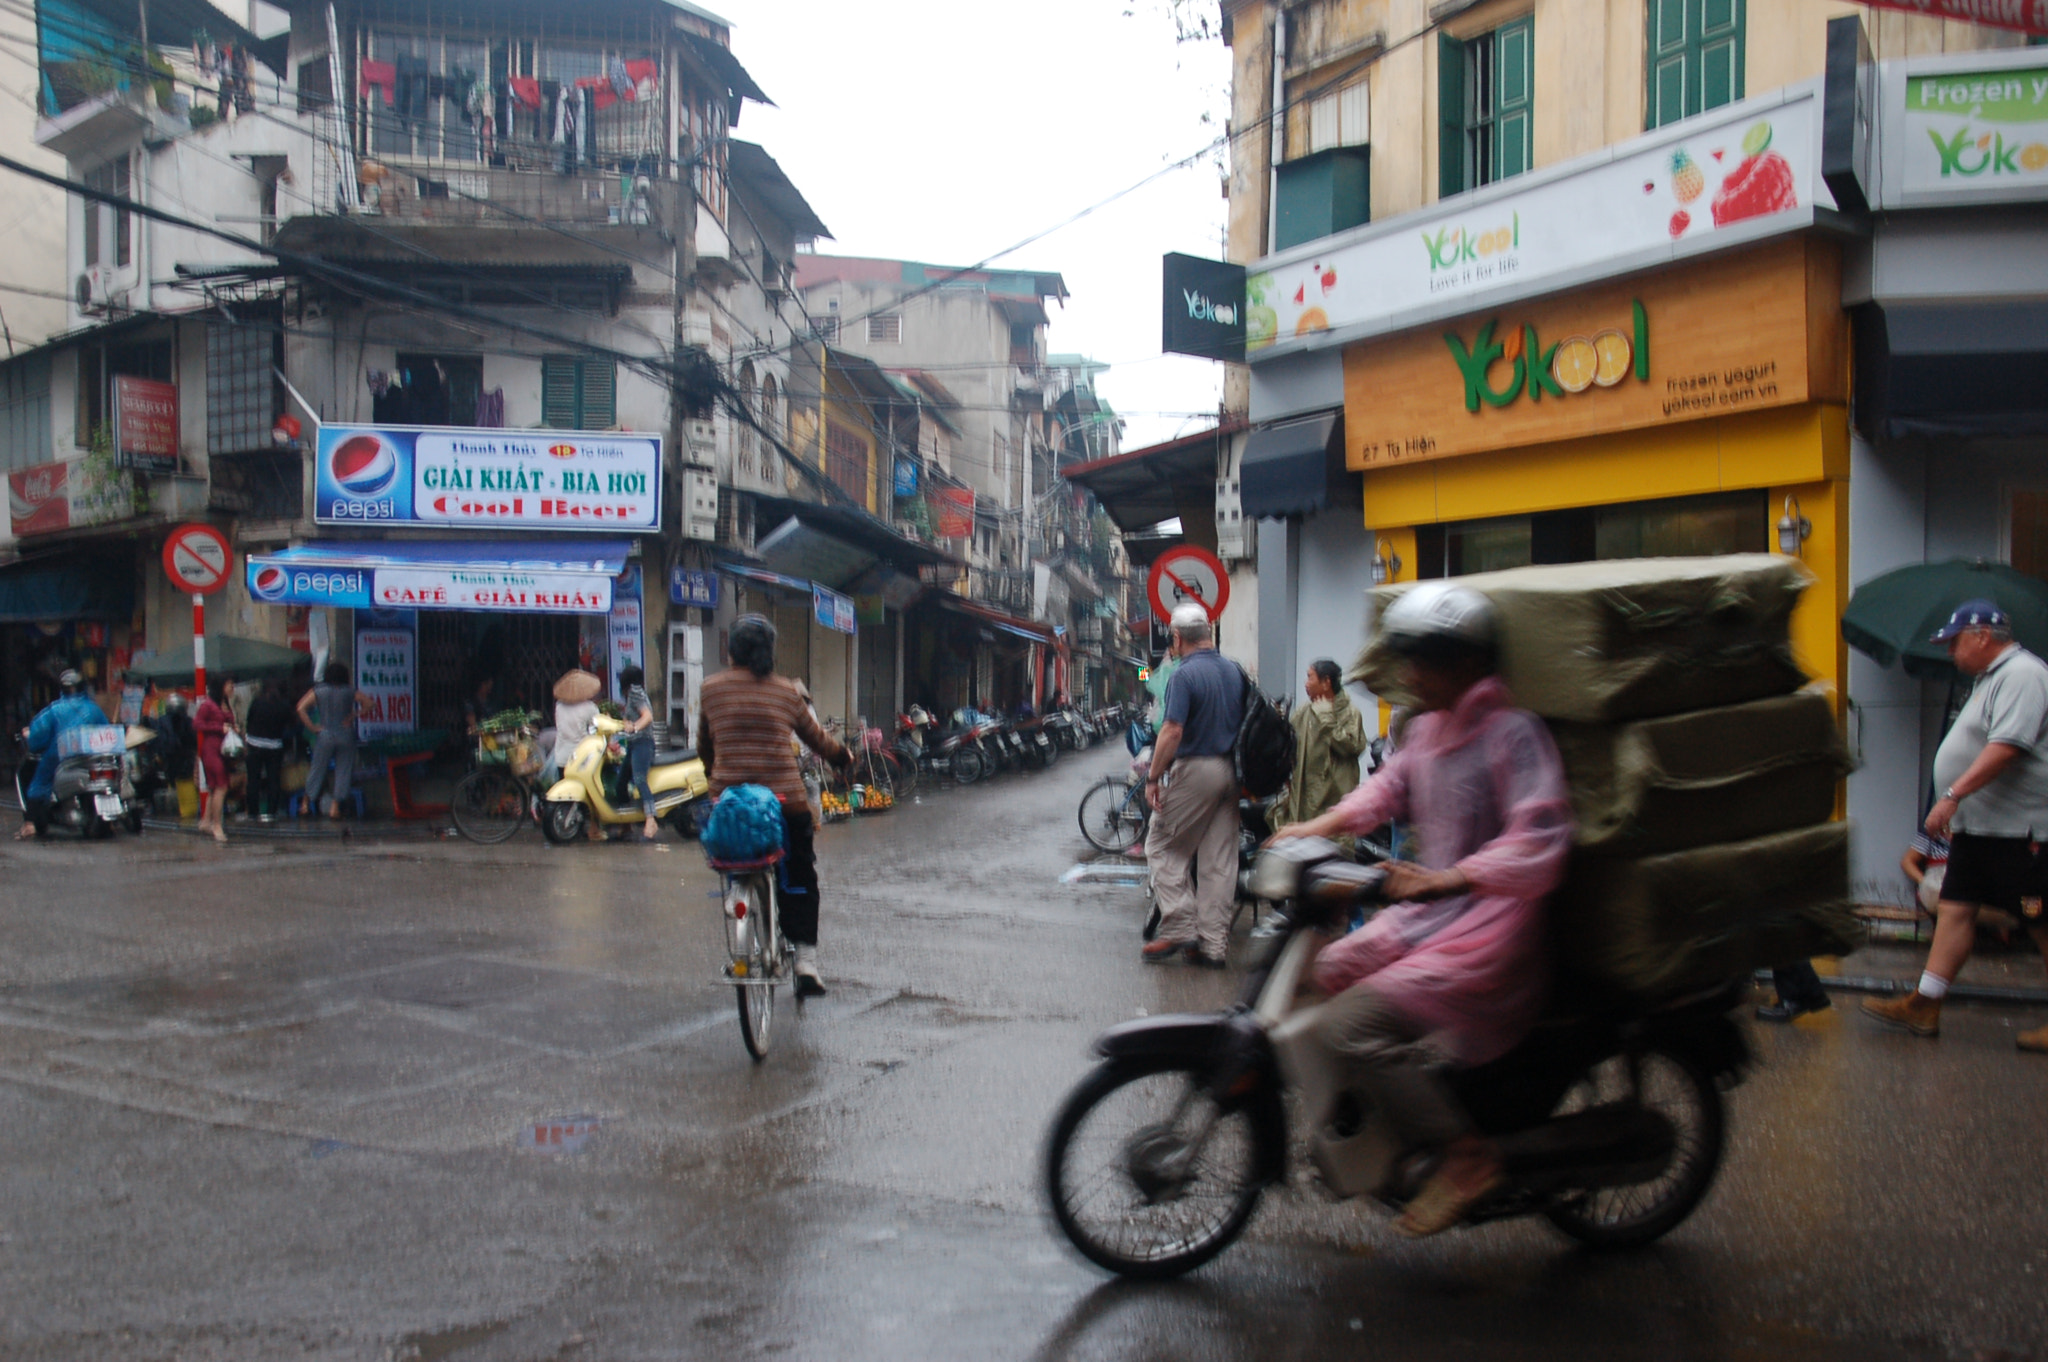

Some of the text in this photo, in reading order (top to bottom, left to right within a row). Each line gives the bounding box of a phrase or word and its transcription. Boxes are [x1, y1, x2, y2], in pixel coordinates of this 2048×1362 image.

[1920, 79, 2023, 107] Frozen
[1498, 254, 1520, 275] life
[452, 440, 497, 456] Thanh
[562, 470, 601, 494] BIA
[332, 498, 394, 520] pepsi
[434, 494, 638, 520] Cool Beer
[294, 570, 363, 597] pepsi
